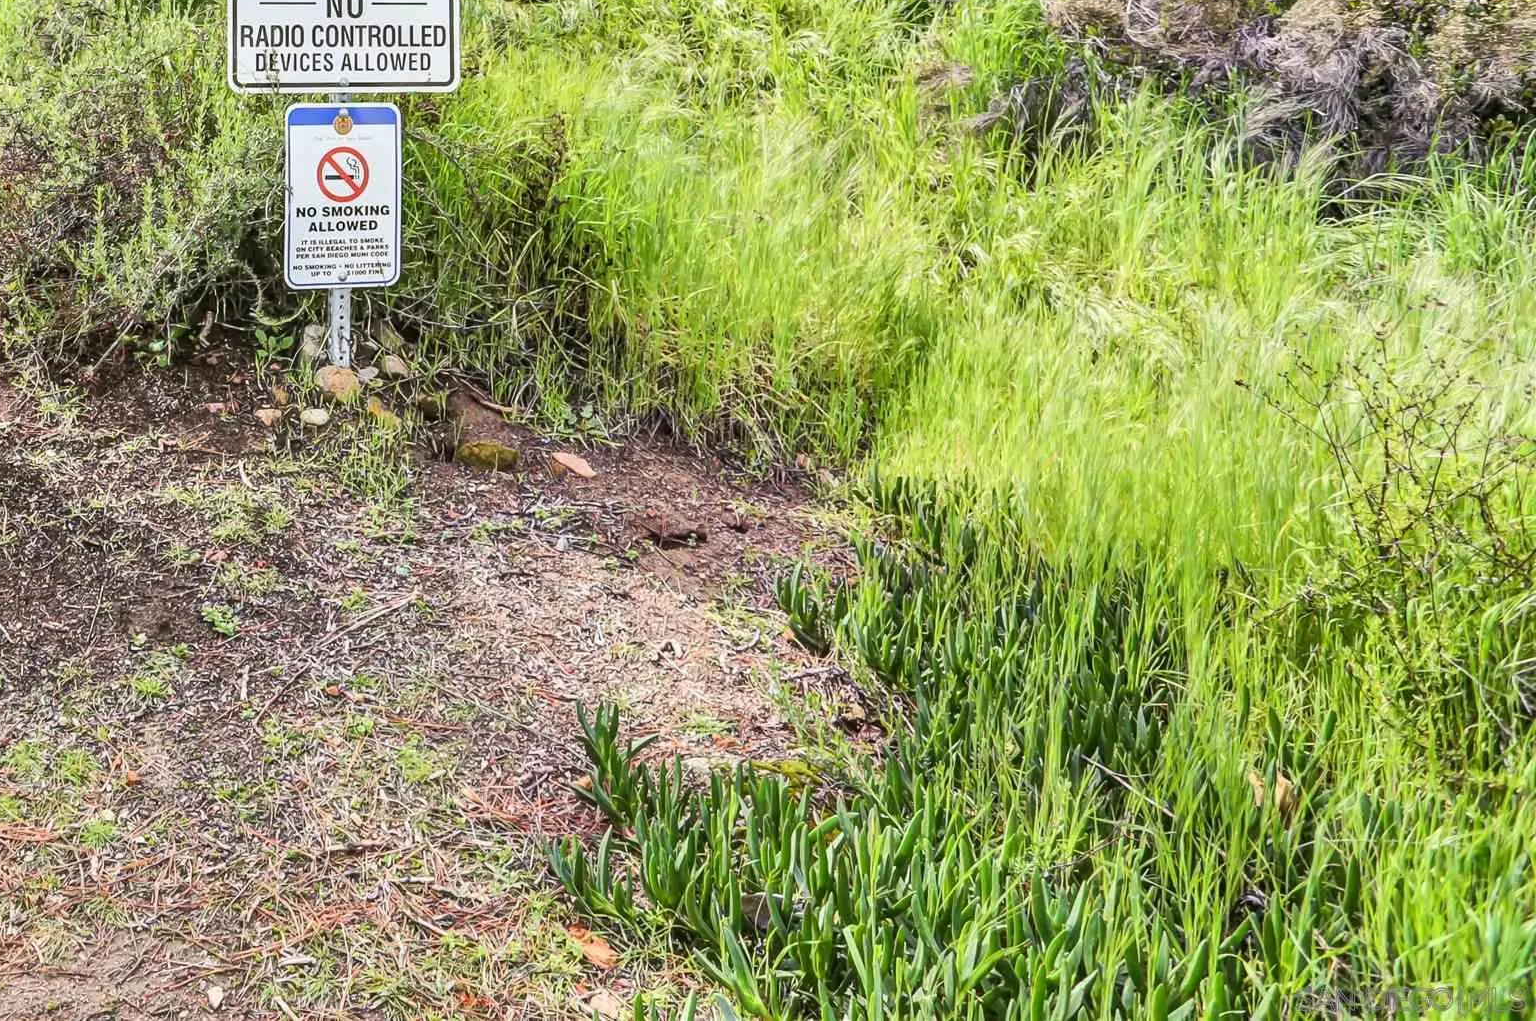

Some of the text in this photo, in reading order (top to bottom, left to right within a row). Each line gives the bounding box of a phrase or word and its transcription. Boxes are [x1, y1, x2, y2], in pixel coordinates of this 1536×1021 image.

[240, 24, 446, 48] RADIO CONTROLLED
[256, 52, 432, 72] DEVICES ALLOWED
[296, 204, 390, 218] NO SMOKING
[308, 220, 378, 233] ALLOWED
